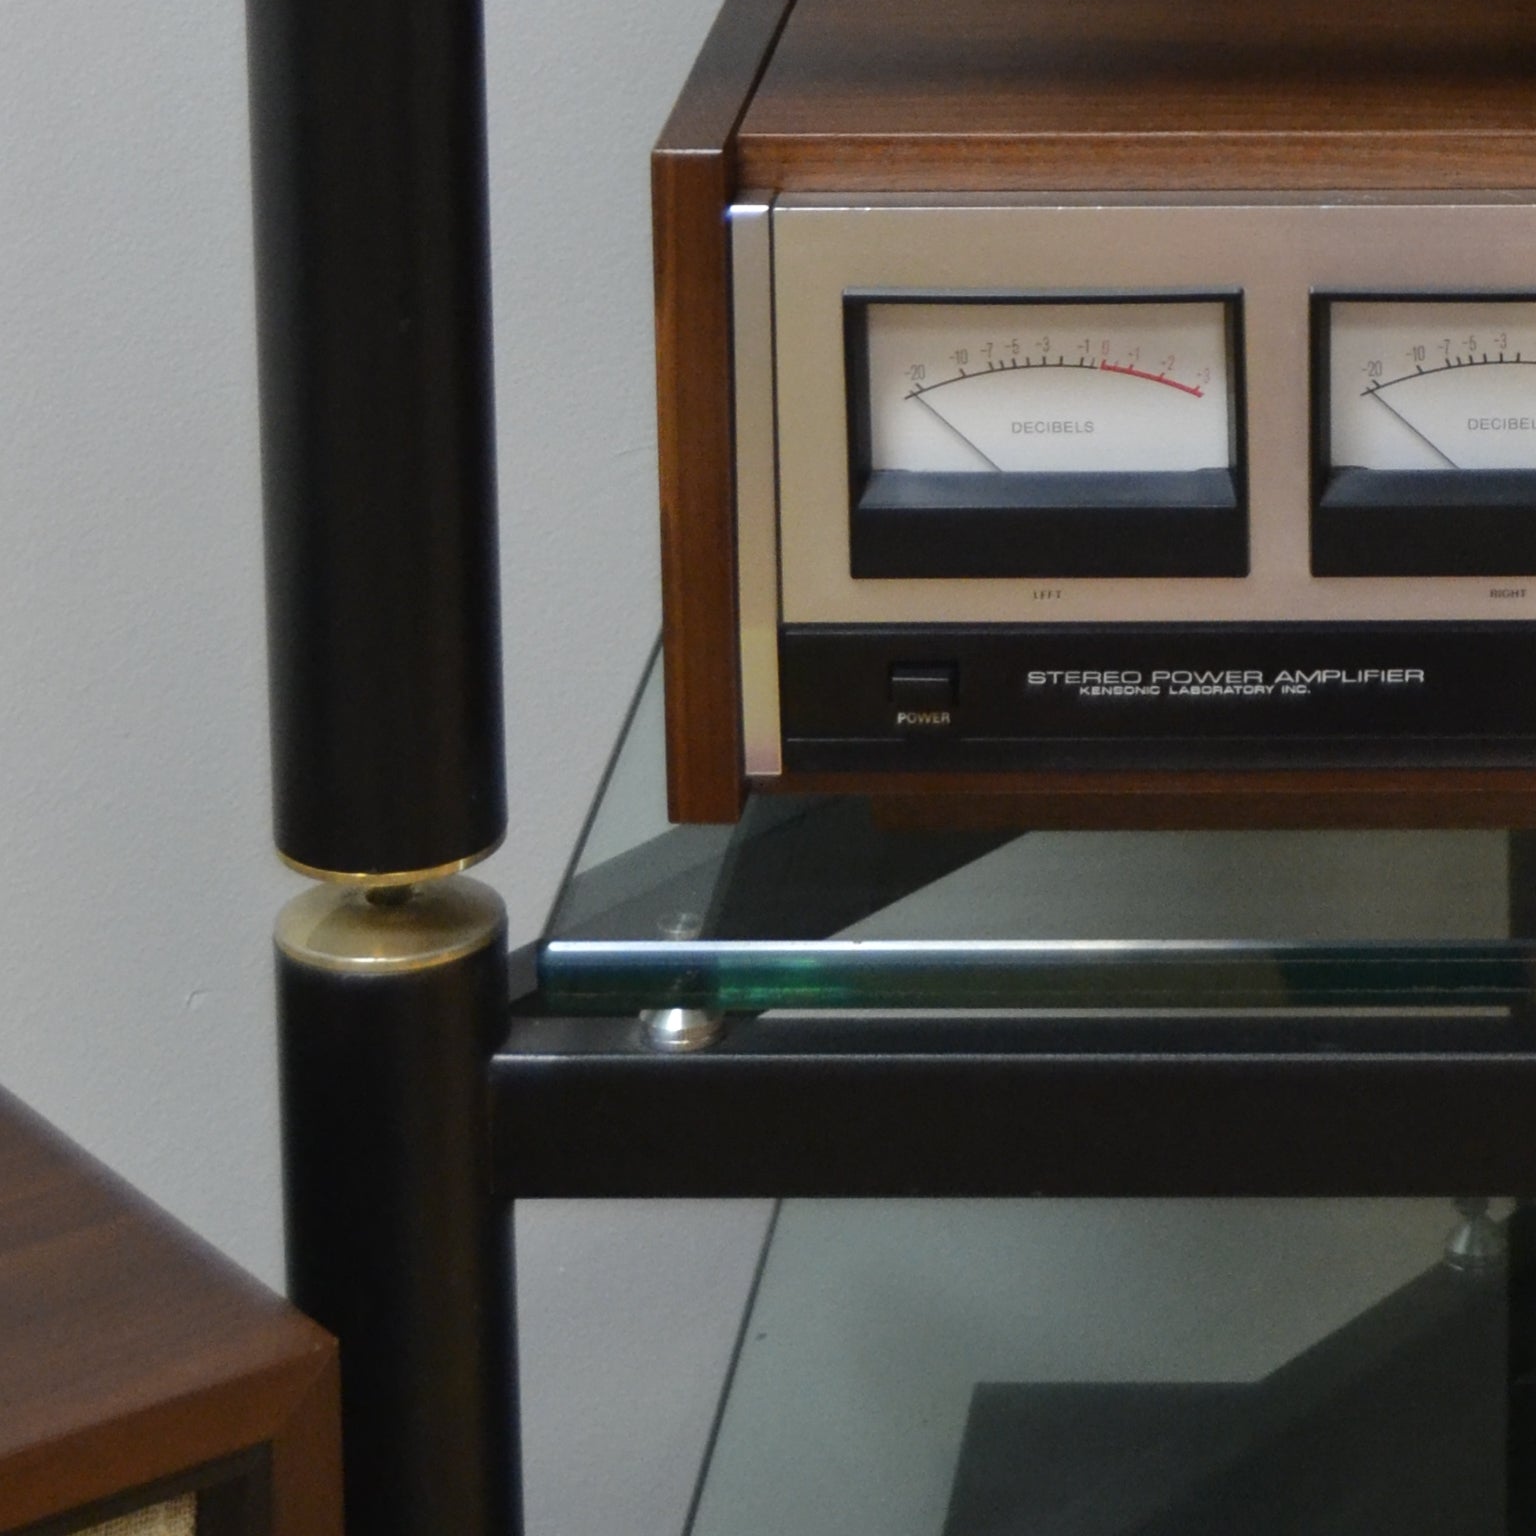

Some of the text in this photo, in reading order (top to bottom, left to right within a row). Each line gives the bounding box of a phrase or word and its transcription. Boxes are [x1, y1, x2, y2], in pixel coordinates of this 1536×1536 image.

[1406, 334, 1506, 362] -10 -5 -3
[950, 349, 968, 364] -10
[1012, 422, 1094, 434] DECIBELS
[1490, 590, 1527, 598] RIGHT
[1027, 669, 1424, 685] STEREO POWER AMPLIFIER
[1080, 686, 1160, 696] KENSONIC
[1169, 686, 1274, 695] LABORATORY
[898, 713, 950, 724] POWER
